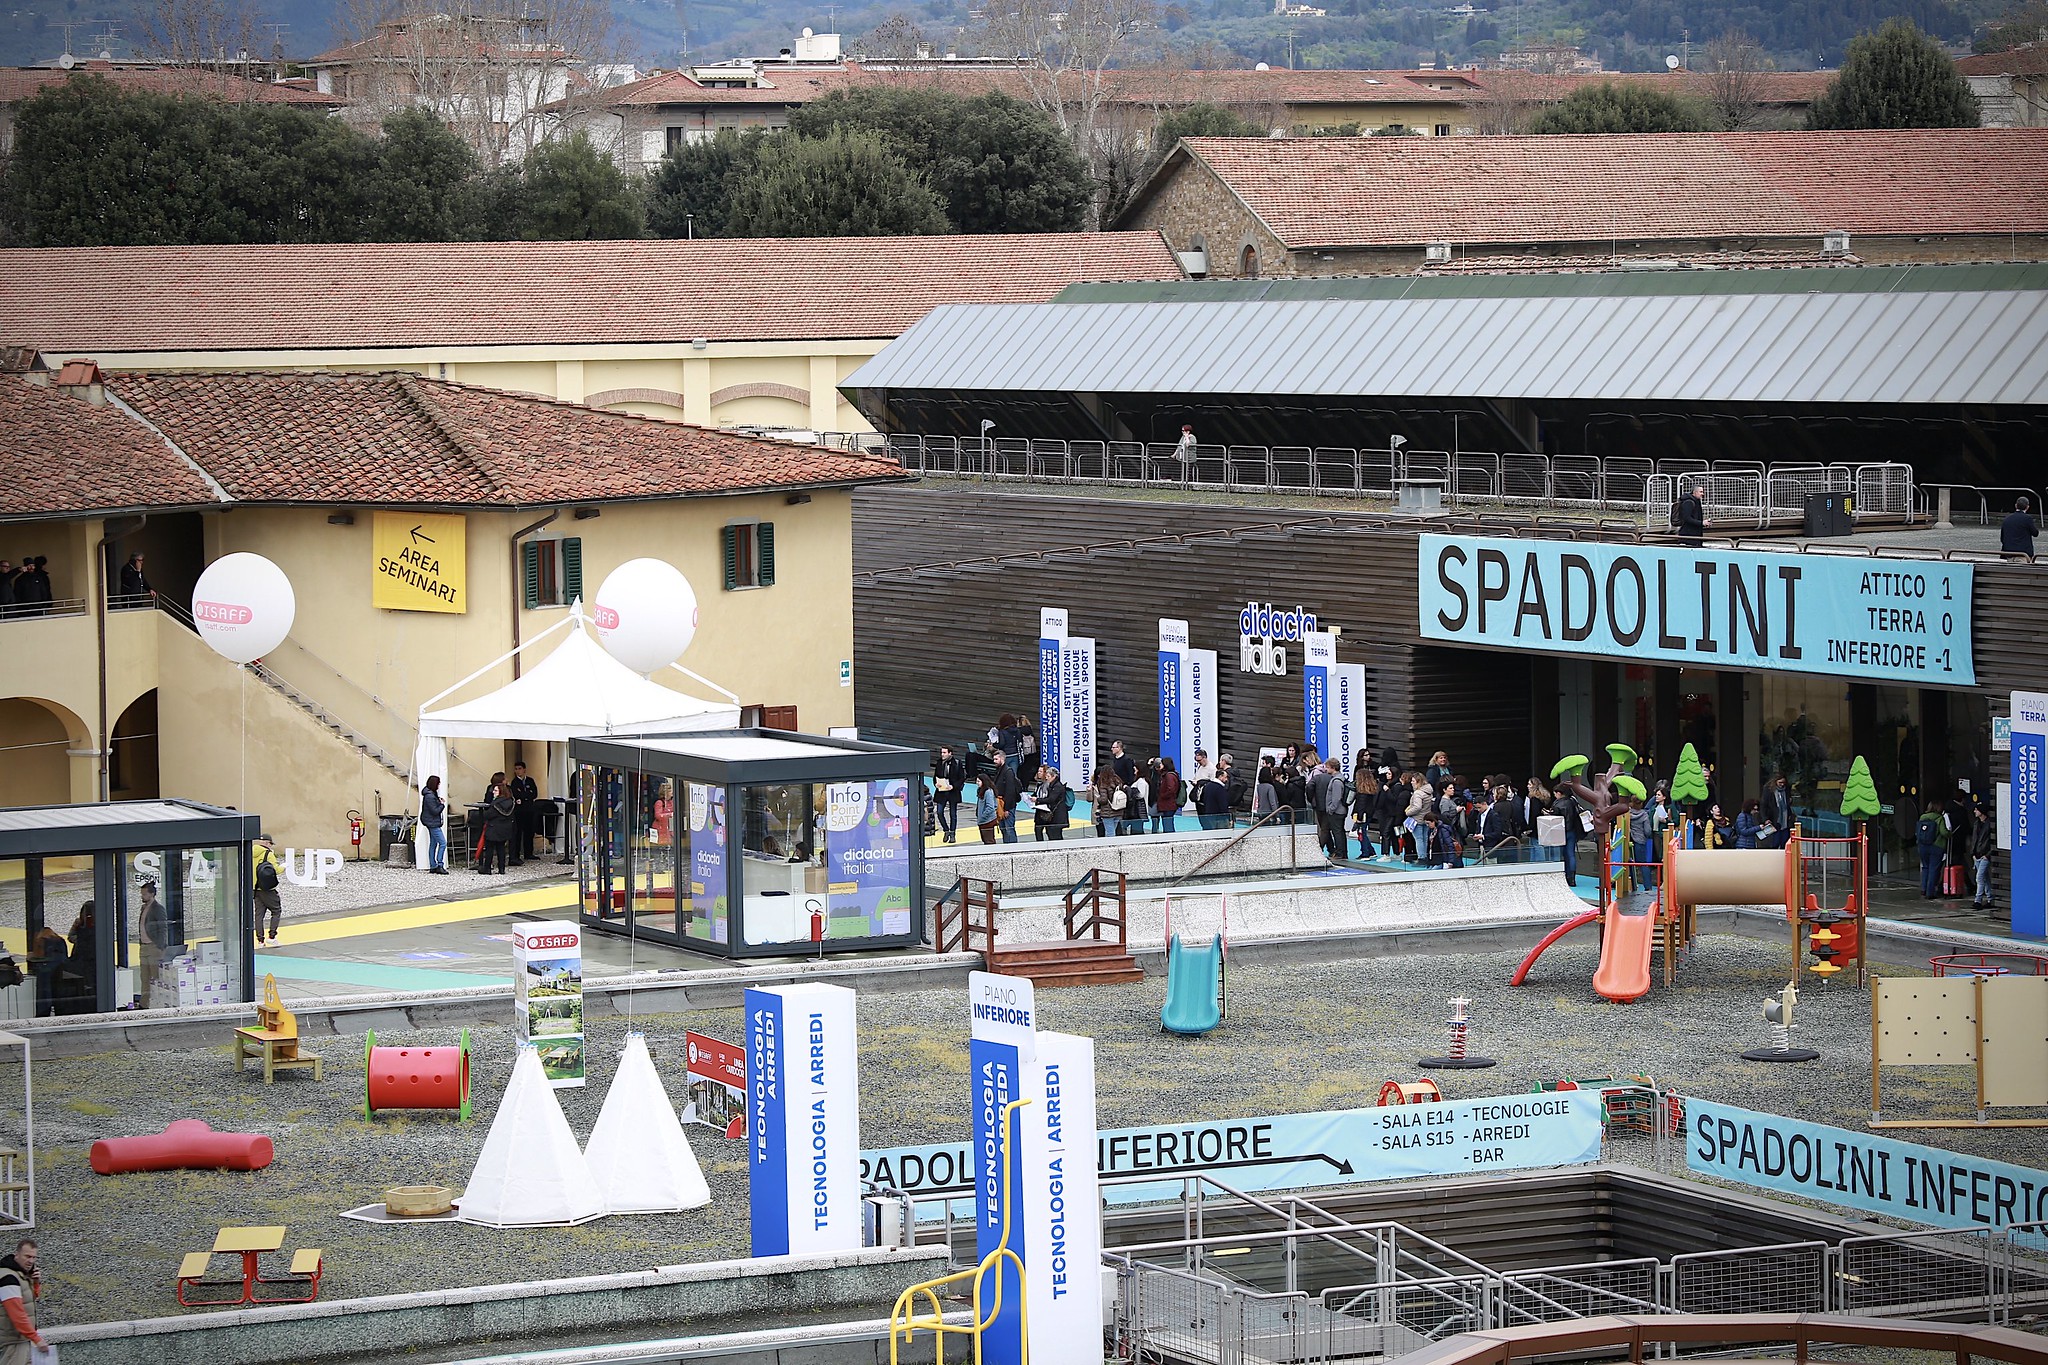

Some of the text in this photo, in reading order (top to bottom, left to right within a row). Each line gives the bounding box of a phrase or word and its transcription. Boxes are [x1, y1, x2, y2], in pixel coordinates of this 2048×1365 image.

[399, 547, 439, 576] AREA
[379, 557, 457, 604] SEMINARI
[1860, 572, 1952, 601] ATTICO 1
[1437, 545, 1802, 660] SPADOLINI
[1045, 618, 1062, 627] ATTICO
[1165, 624, 1181, 634] PIANO
[1240, 603, 1316, 640] didacta
[1867, 608, 1953, 636] TERRA 0
[1161, 633, 1187, 644] INFERIORE
[1311, 638, 1328, 647] PIANO
[1311, 647, 1329, 657] TERRA
[1240, 636, 1286, 674] italia
[1827, 639, 1926, 670] INFERIORE
[1193, 662, 1201, 701] ARREDI
[1163, 660, 1171, 742] TECNOLOGIA
[1340, 676, 1348, 717] ARREDI
[2021, 699, 2045, 711] PIANO
[1073, 693, 1081, 759] FORMAZIONE
[2020, 711, 2047, 723] TERRA
[2029, 746, 2038, 804] ARREDI
[691, 787, 705, 804] Info
[831, 786, 861, 803] Info
[2019, 744, 2027, 847] TECNOLOGIA
[831, 804, 860, 816] Point
[285, 848, 344, 887] UP
[697, 850, 720, 865] didacta
[843, 847, 894, 861] didacta
[697, 865, 711, 878] italia
[843, 862, 874, 875] italia
[539, 935, 575, 947] ISAFF
[984, 985, 1016, 1006] PIANO
[974, 1003, 1031, 1028] INFERIORE
[765, 1011, 777, 1100] ARREDI
[754, 1009, 768, 1165] TECNOLOGIA
[810, 1013, 827, 1231] TECNOLOGIA ARREDI
[1427, 1110, 1455, 1125] E14
[982, 1061, 999, 1228] TECNOLOGIA
[1426, 1131, 1454, 1146] S15
[1697, 1114, 1892, 1201] SPADOLINI
[1046, 1065, 1066, 1300] TECNOLOGIA ARREDI
